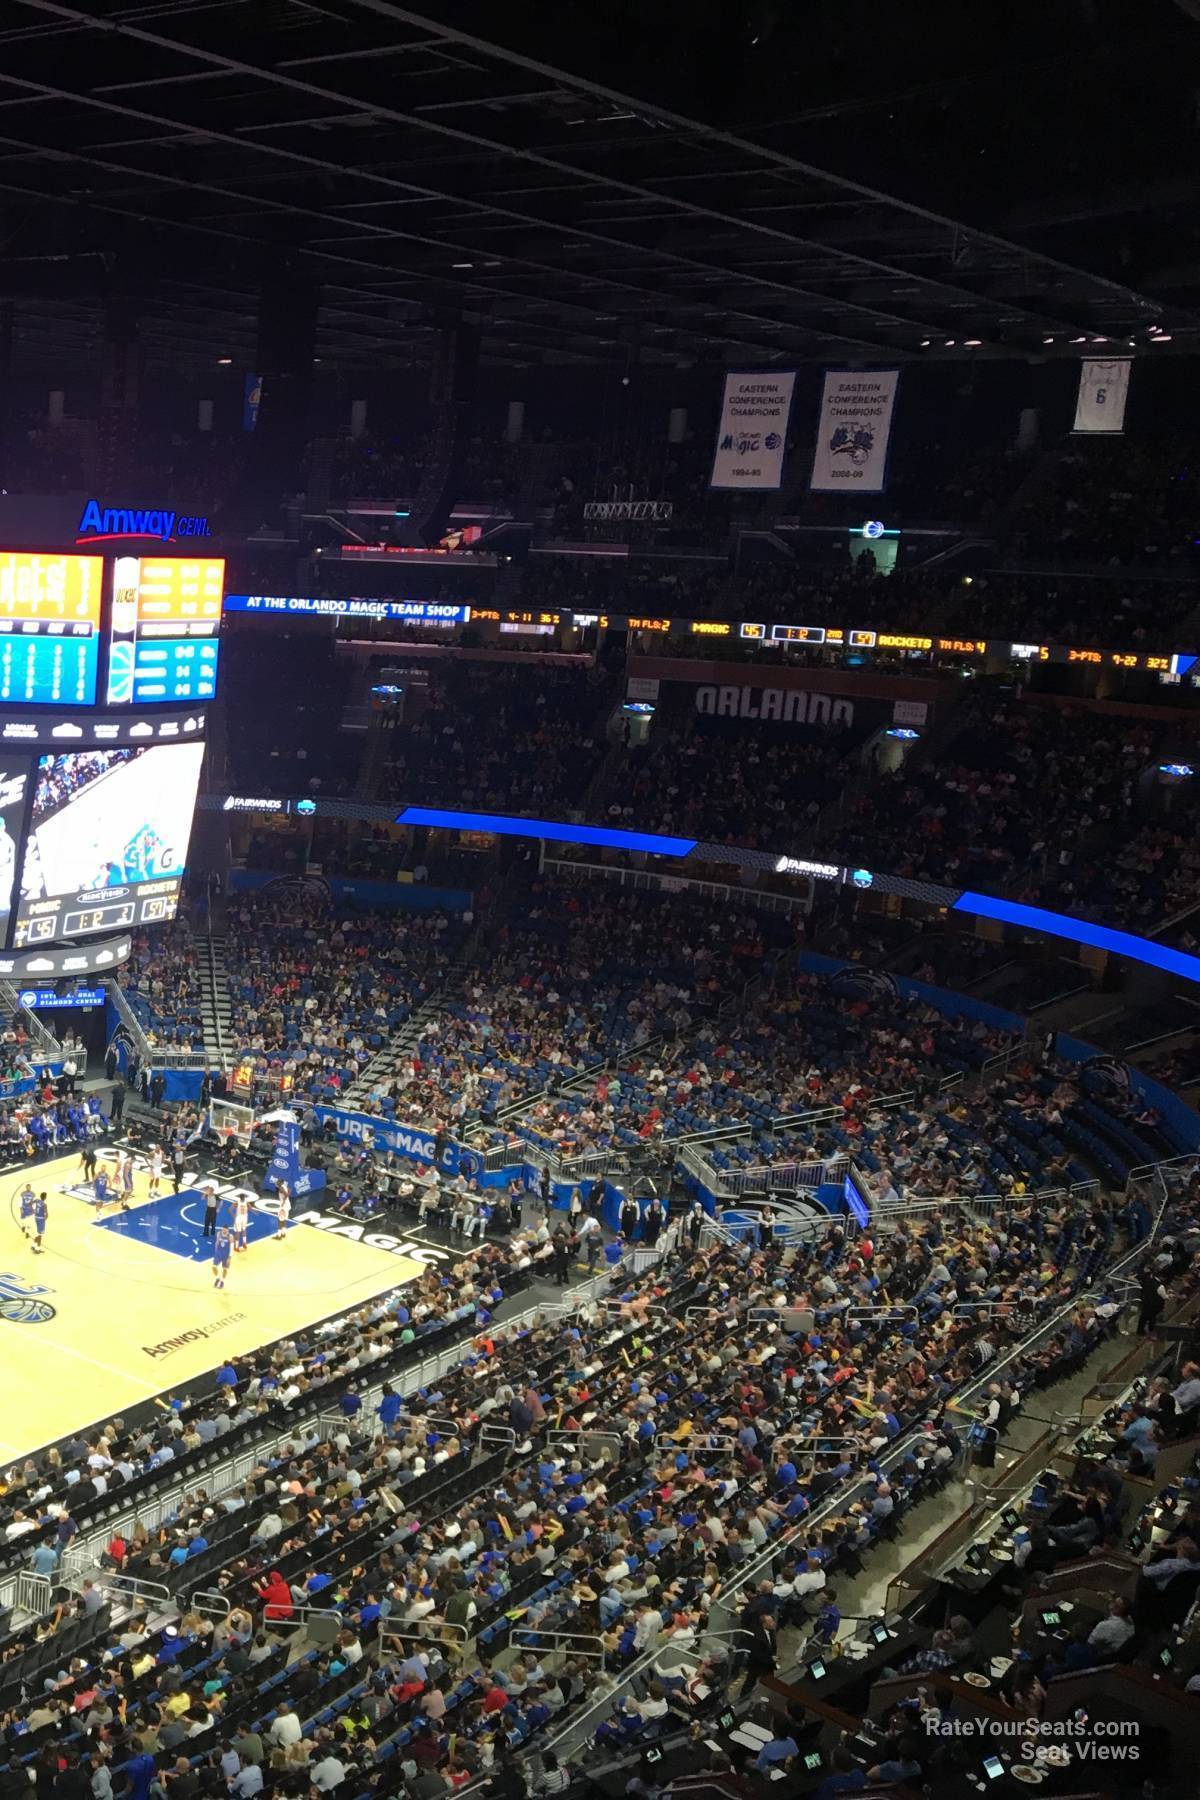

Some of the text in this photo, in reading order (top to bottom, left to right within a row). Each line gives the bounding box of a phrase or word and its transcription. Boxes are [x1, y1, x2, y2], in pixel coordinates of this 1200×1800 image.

[739, 384, 778, 393] EASTERN
[838, 383, 881, 392] EASTERN
[729, 396, 786, 404] CONFERENCE
[828, 395, 888, 404] CONFERENCE
[1096, 388, 1106, 404] 6
[731, 408, 781, 416] CHAMPIONS
[830, 408, 883, 416] CHAMPIONS
[79, 499, 175, 541] Amway
[247, 596, 263, 607] AT
[264, 597, 286, 609] THE
[289, 598, 346, 612] ORLANDO
[349, 601, 388, 614] MAGIC
[390, 603, 424, 616] TEAM
[426, 605, 460, 618] SHOP
[692, 622, 730, 634] MAGIC
[745, 625, 760, 637] 45
[879, 635, 932, 649] ROCKETS
[696, 685, 855, 728] ORLANDO
[235, 798, 283, 809] FAIRWINDS
[29, 900, 61, 915] MAGIC
[396, 1132, 453, 1166] MAGC
[294, 1211, 450, 1266] MAGIC
[142, 1312, 247, 1357] Amway CENTER
